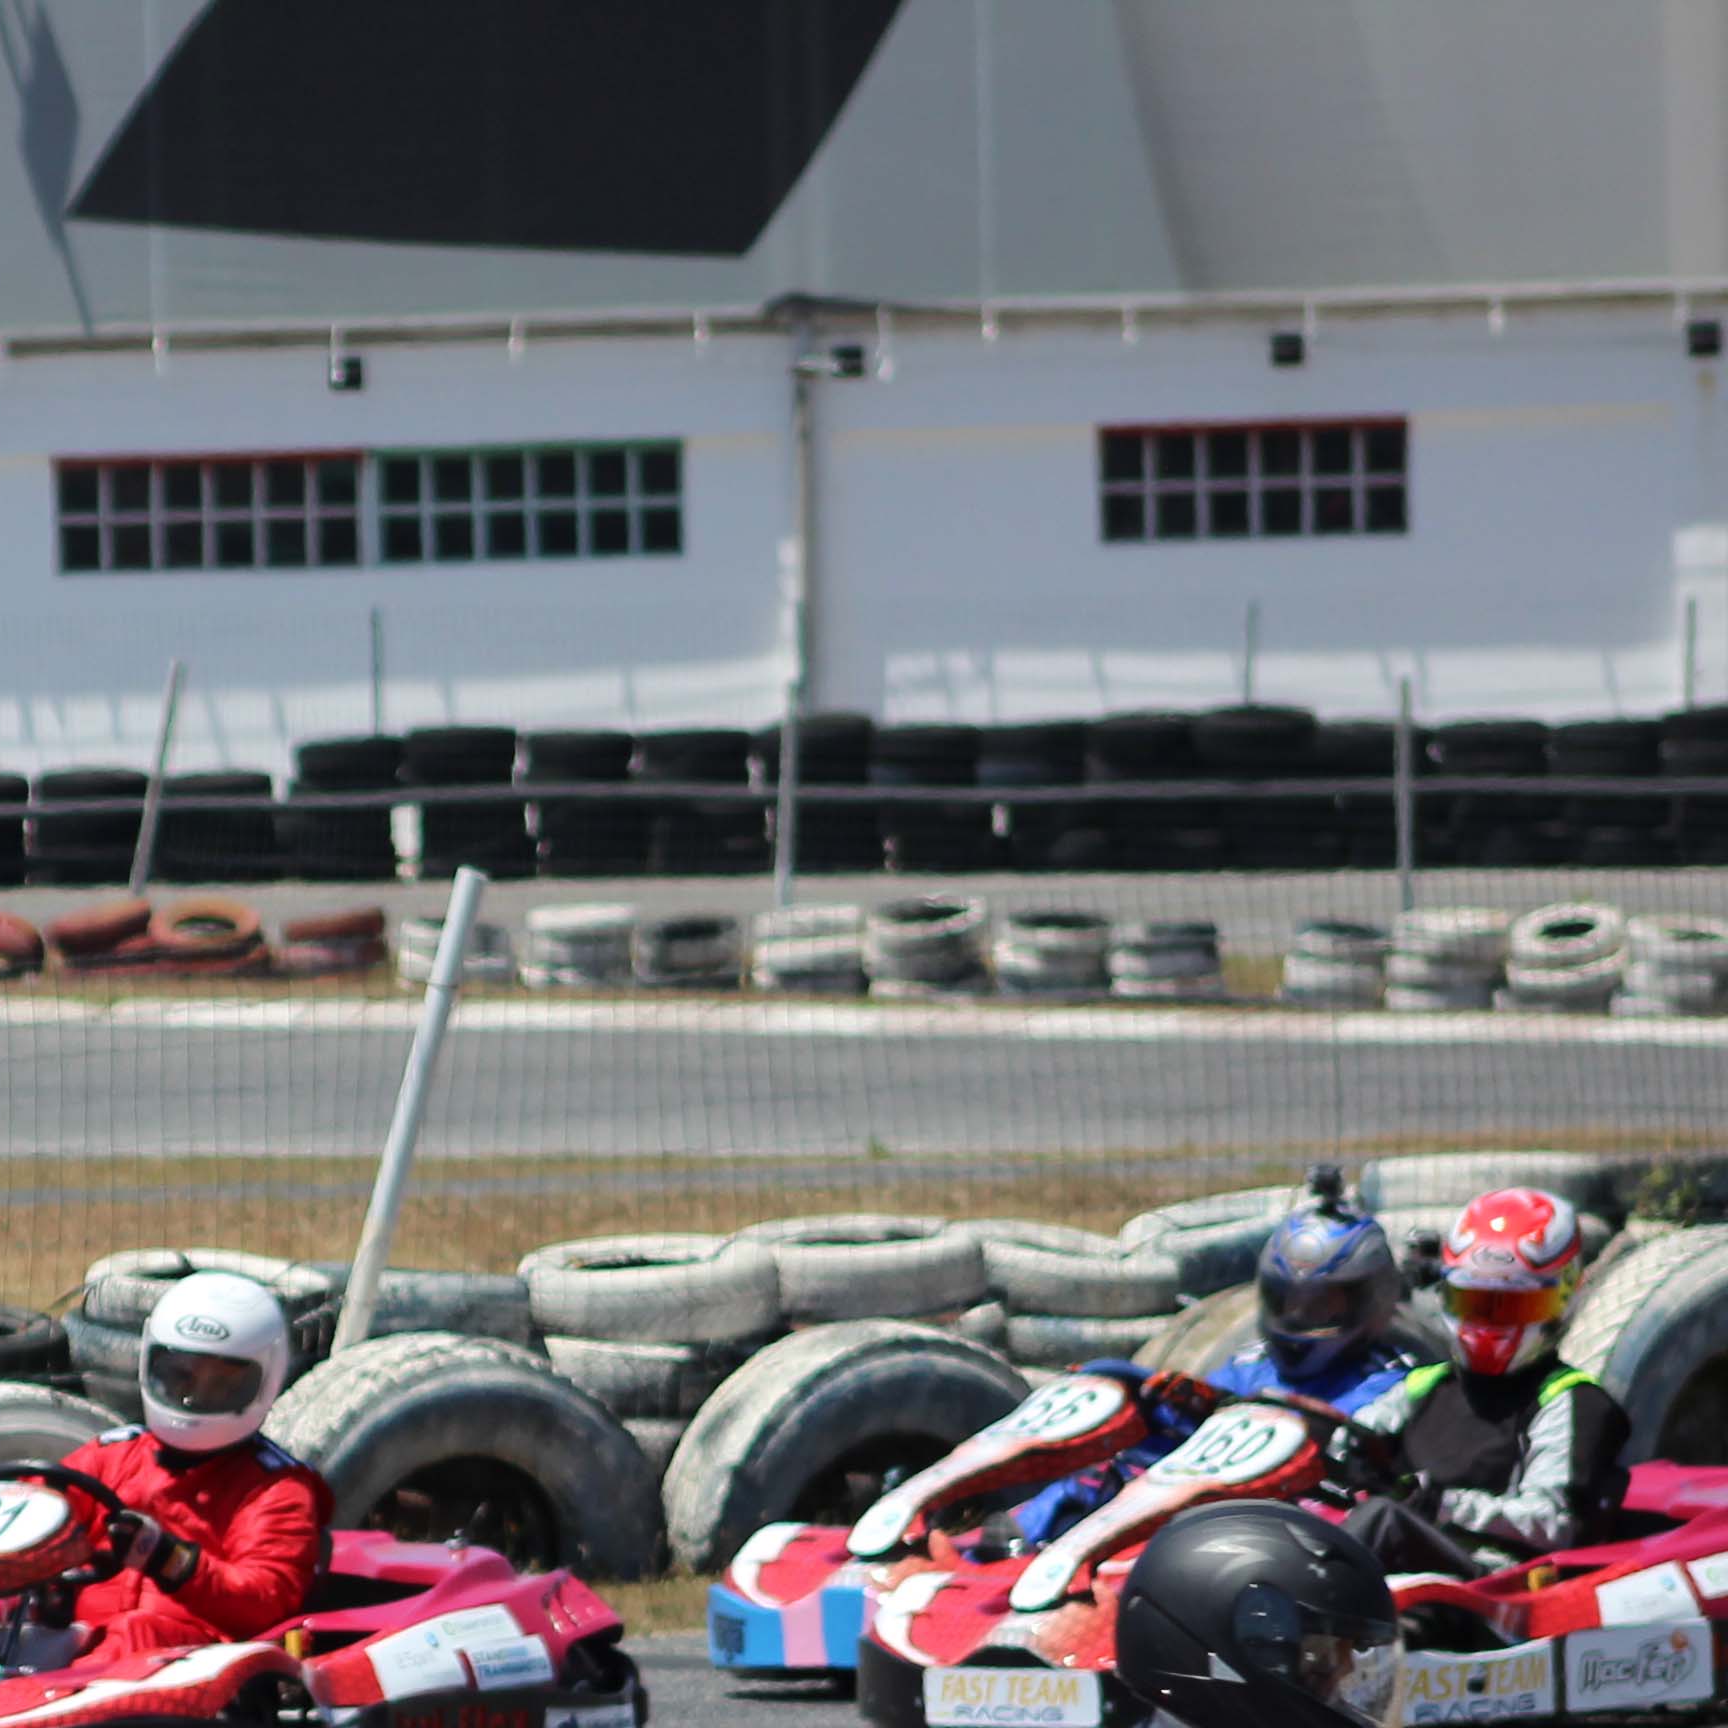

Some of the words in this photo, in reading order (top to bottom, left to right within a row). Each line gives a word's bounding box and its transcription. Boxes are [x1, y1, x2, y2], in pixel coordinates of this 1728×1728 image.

[941, 1674, 995, 1703] FAST
[1007, 1675, 1081, 1706] TEAM
[1481, 1653, 1548, 1696] TEAM
[954, 1704, 1065, 1722] RACING
